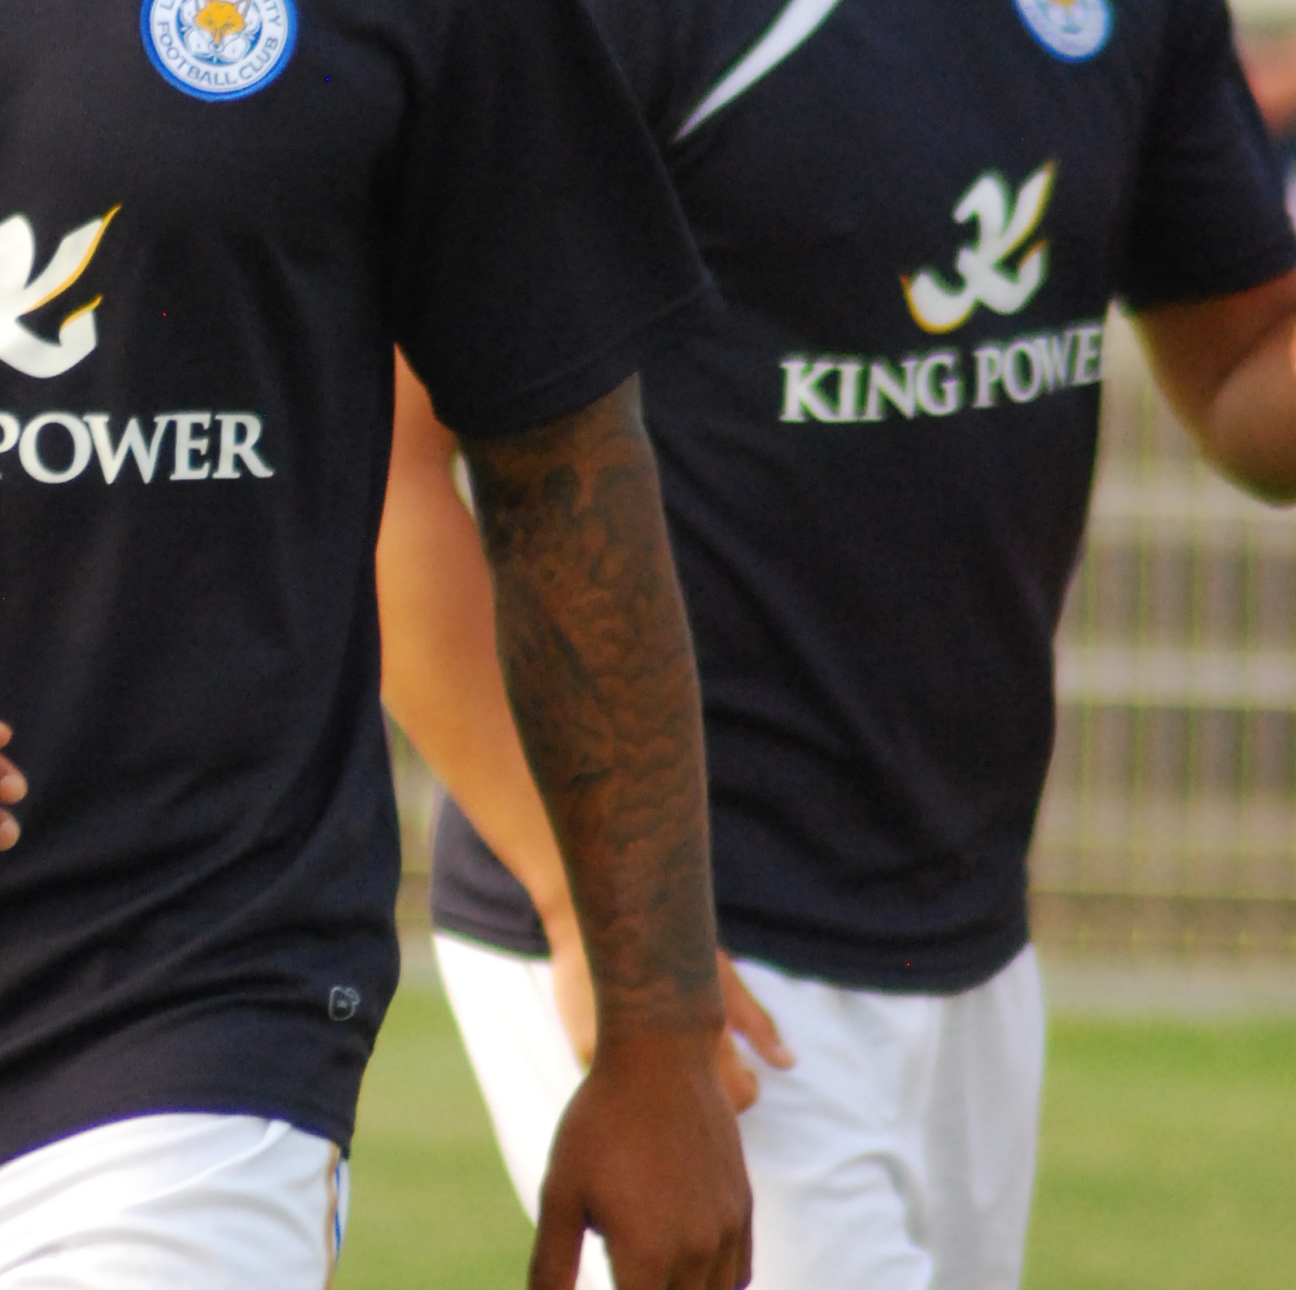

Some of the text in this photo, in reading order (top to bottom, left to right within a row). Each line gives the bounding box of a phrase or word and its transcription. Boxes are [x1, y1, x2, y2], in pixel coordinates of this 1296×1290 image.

[156, 21, 279, 87] FOOTBALL CLUB
[778, 321, 1104, 424] KING POWE
